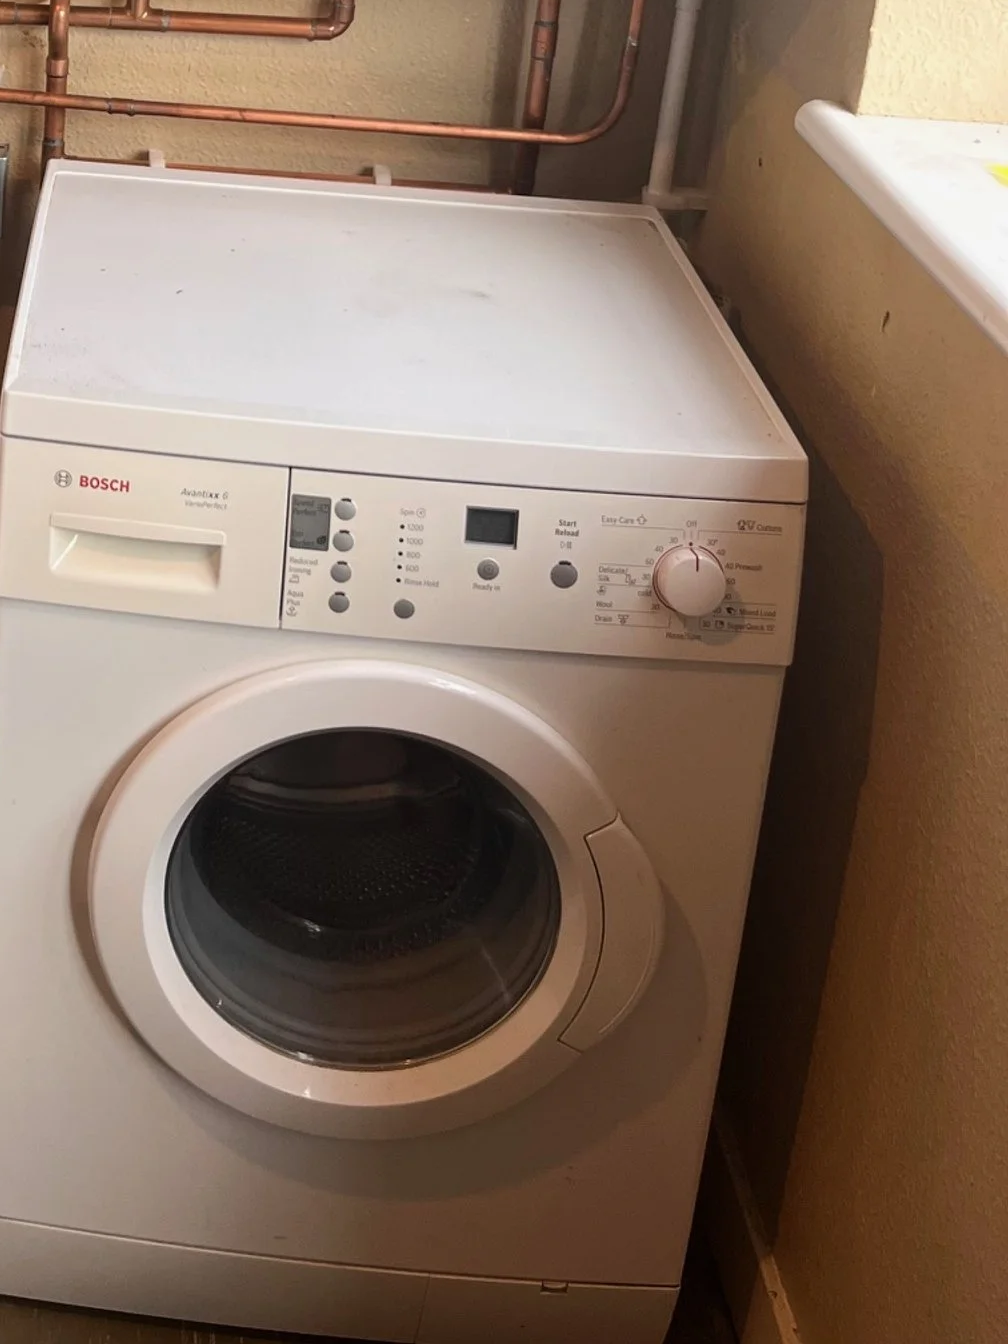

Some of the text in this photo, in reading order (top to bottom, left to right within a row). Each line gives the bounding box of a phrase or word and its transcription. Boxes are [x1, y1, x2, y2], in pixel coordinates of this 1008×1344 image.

[79, 474, 131, 493] BOSCH
[180, 487, 220, 500] Avantixx
[558, 519, 577, 528] Start
[601, 514, 635, 525] Easy Care
[407, 524, 424, 532] 1200
[555, 528, 580, 537] Reload
[406, 538, 424, 546] 1000
[404, 578, 422, 587] Rinse
[286, 589, 304, 599] Aqua
[286, 598, 301, 607] Plus
[594, 614, 613, 623] Drain
